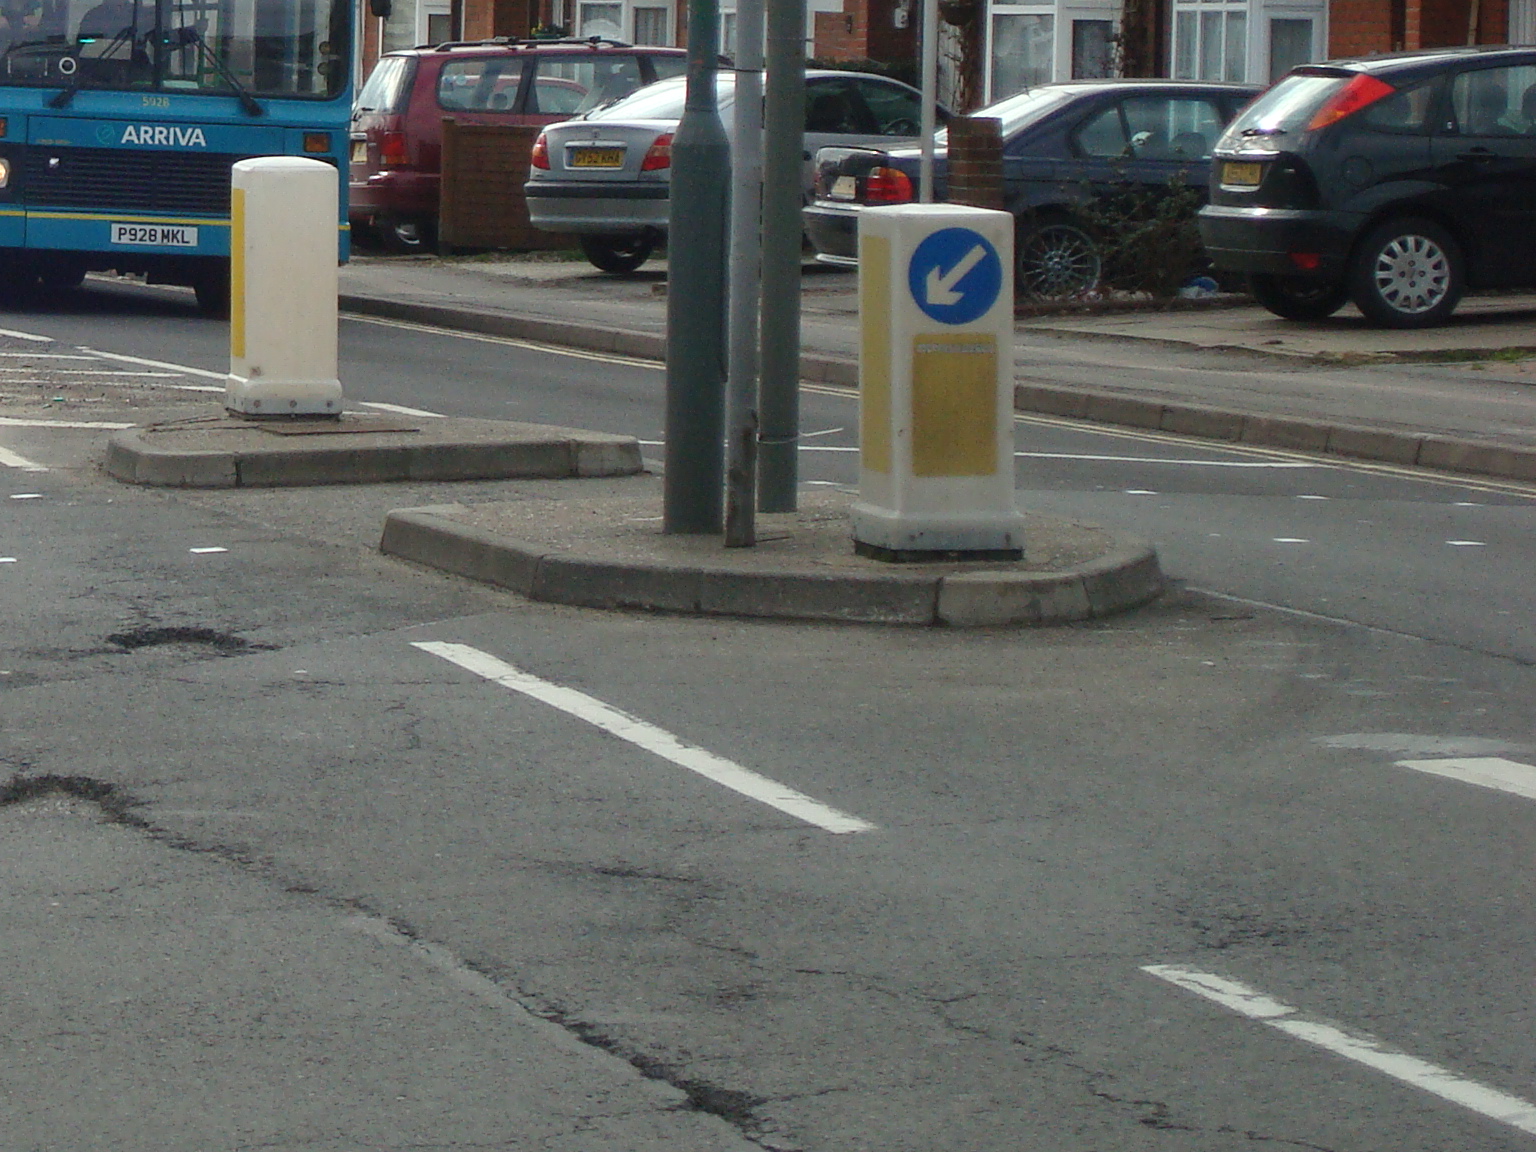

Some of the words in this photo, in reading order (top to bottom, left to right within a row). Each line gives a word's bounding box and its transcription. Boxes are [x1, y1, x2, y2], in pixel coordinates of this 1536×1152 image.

[142, 97, 170, 108] 5928
[121, 125, 206, 147] ARRIVA
[117, 227, 158, 243] P928
[161, 229, 190, 244] MKL
